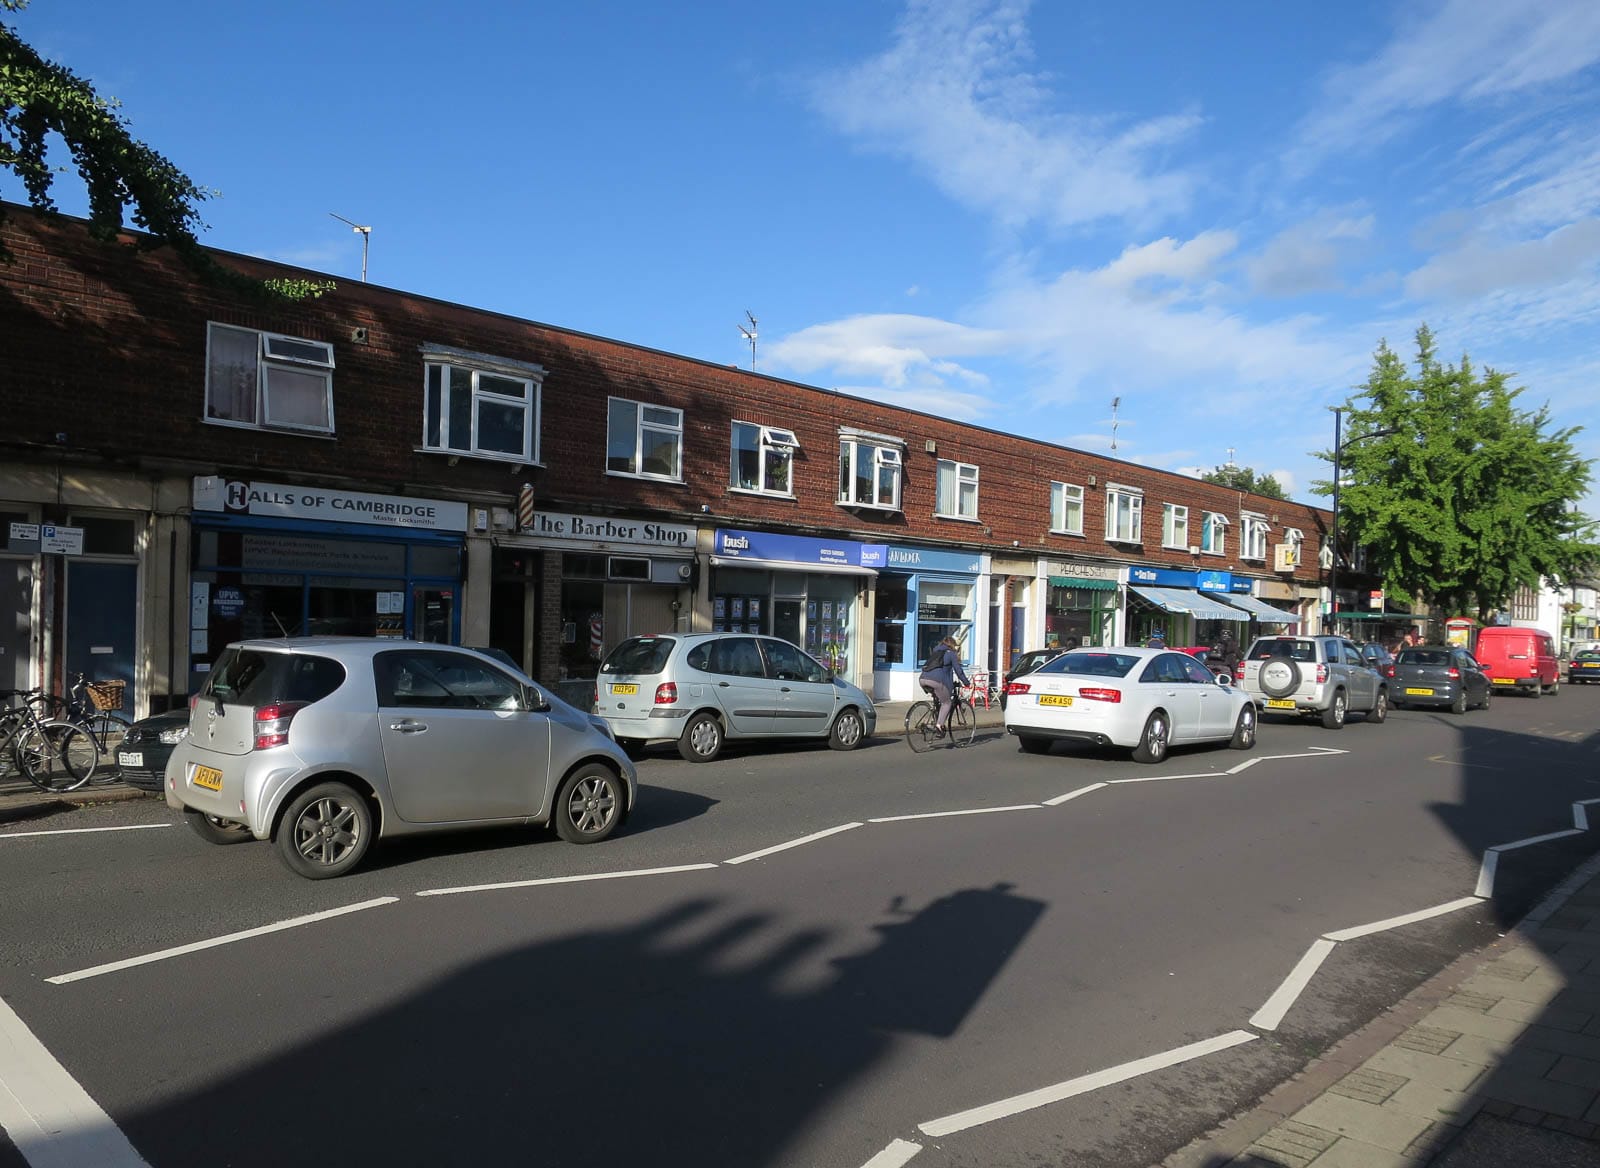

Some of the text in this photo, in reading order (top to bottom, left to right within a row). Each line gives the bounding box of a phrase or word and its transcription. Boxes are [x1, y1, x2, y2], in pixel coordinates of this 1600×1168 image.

[227, 484, 436, 517] HALLS OF CAMBRIDGE
[399, 517, 434, 525] Locksmiths
[531, 513, 688, 545] The Barber Shop
[724, 534, 749, 549] bush
[862, 551, 879, 560] bush
[1040, 696, 1057, 704] AK64
